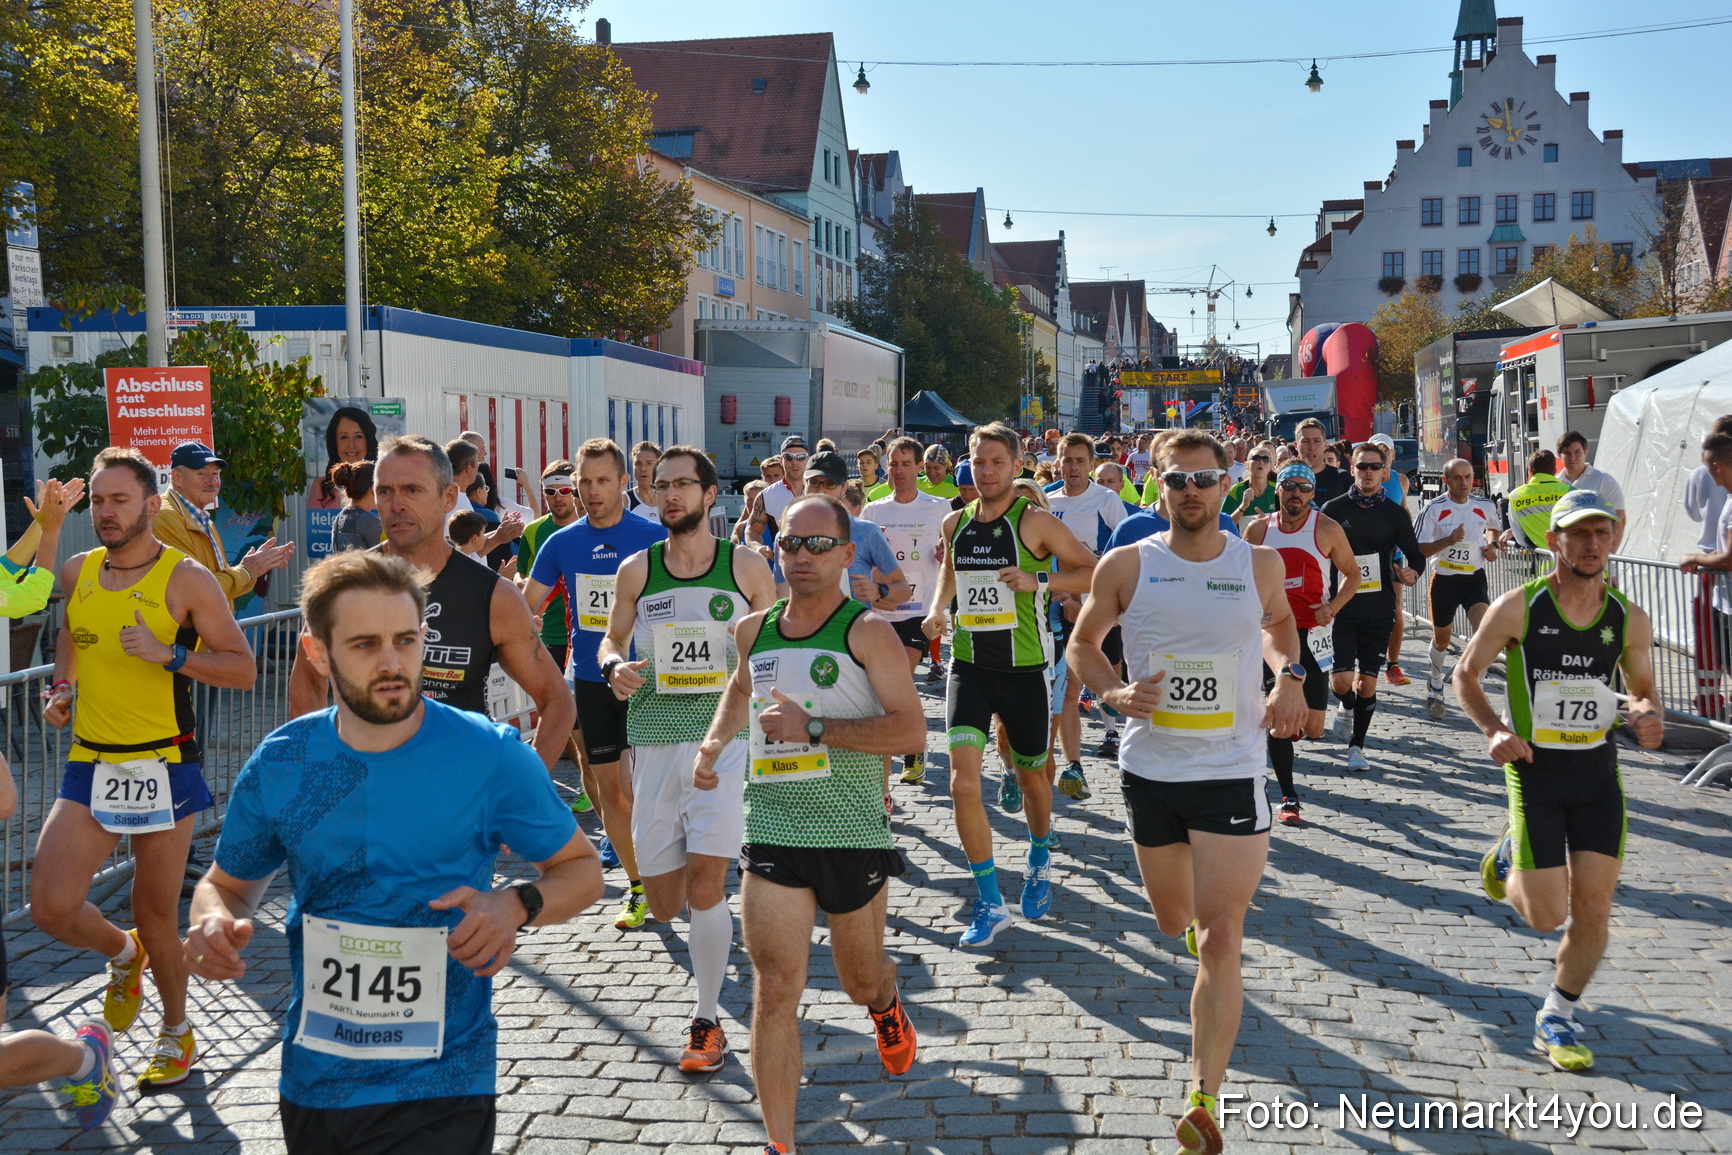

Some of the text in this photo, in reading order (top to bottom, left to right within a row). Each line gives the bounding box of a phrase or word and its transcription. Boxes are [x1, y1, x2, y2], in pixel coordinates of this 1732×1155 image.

[11, 262, 39, 274] Parkschein
[14, 274, 38, 286] werktags
[1152, 373, 1188, 383] START
[115, 377, 204, 393] Abschluss
[116, 394, 145, 403] statt
[117, 404, 205, 418] Ausschluss!
[133, 425, 202, 436] Mehr Lehrer für
[130, 437, 167, 446] kleinere
[311, 542, 333, 552] CSU
[972, 546, 992, 554] DAV
[956, 556, 1009, 565] Röthenbach
[1448, 548, 1470, 561] 213
[968, 587, 999, 606] 243
[975, 616, 995, 624] Oliver
[675, 627, 706, 635] BOCK
[671, 641, 711, 662] 244
[1174, 661, 1214, 670] BOCK
[1561, 654, 1594, 667] DAV
[668, 675, 716, 687] Christopher
[1169, 676, 1217, 702] 328
[1560, 686, 1594, 695] BOCK
[1555, 700, 1598, 721] 178
[1560, 732, 1588, 743] Ralph
[772, 761, 799, 771] Klaus
[104, 778, 158, 801] 2179
[114, 814, 149, 825] Sascha
[340, 935, 402, 955] BOCK
[322, 957, 422, 1004] 2145
[329, 1003, 400, 1018] PARTL Neumarkt
[334, 1023, 404, 1044] Andreas
